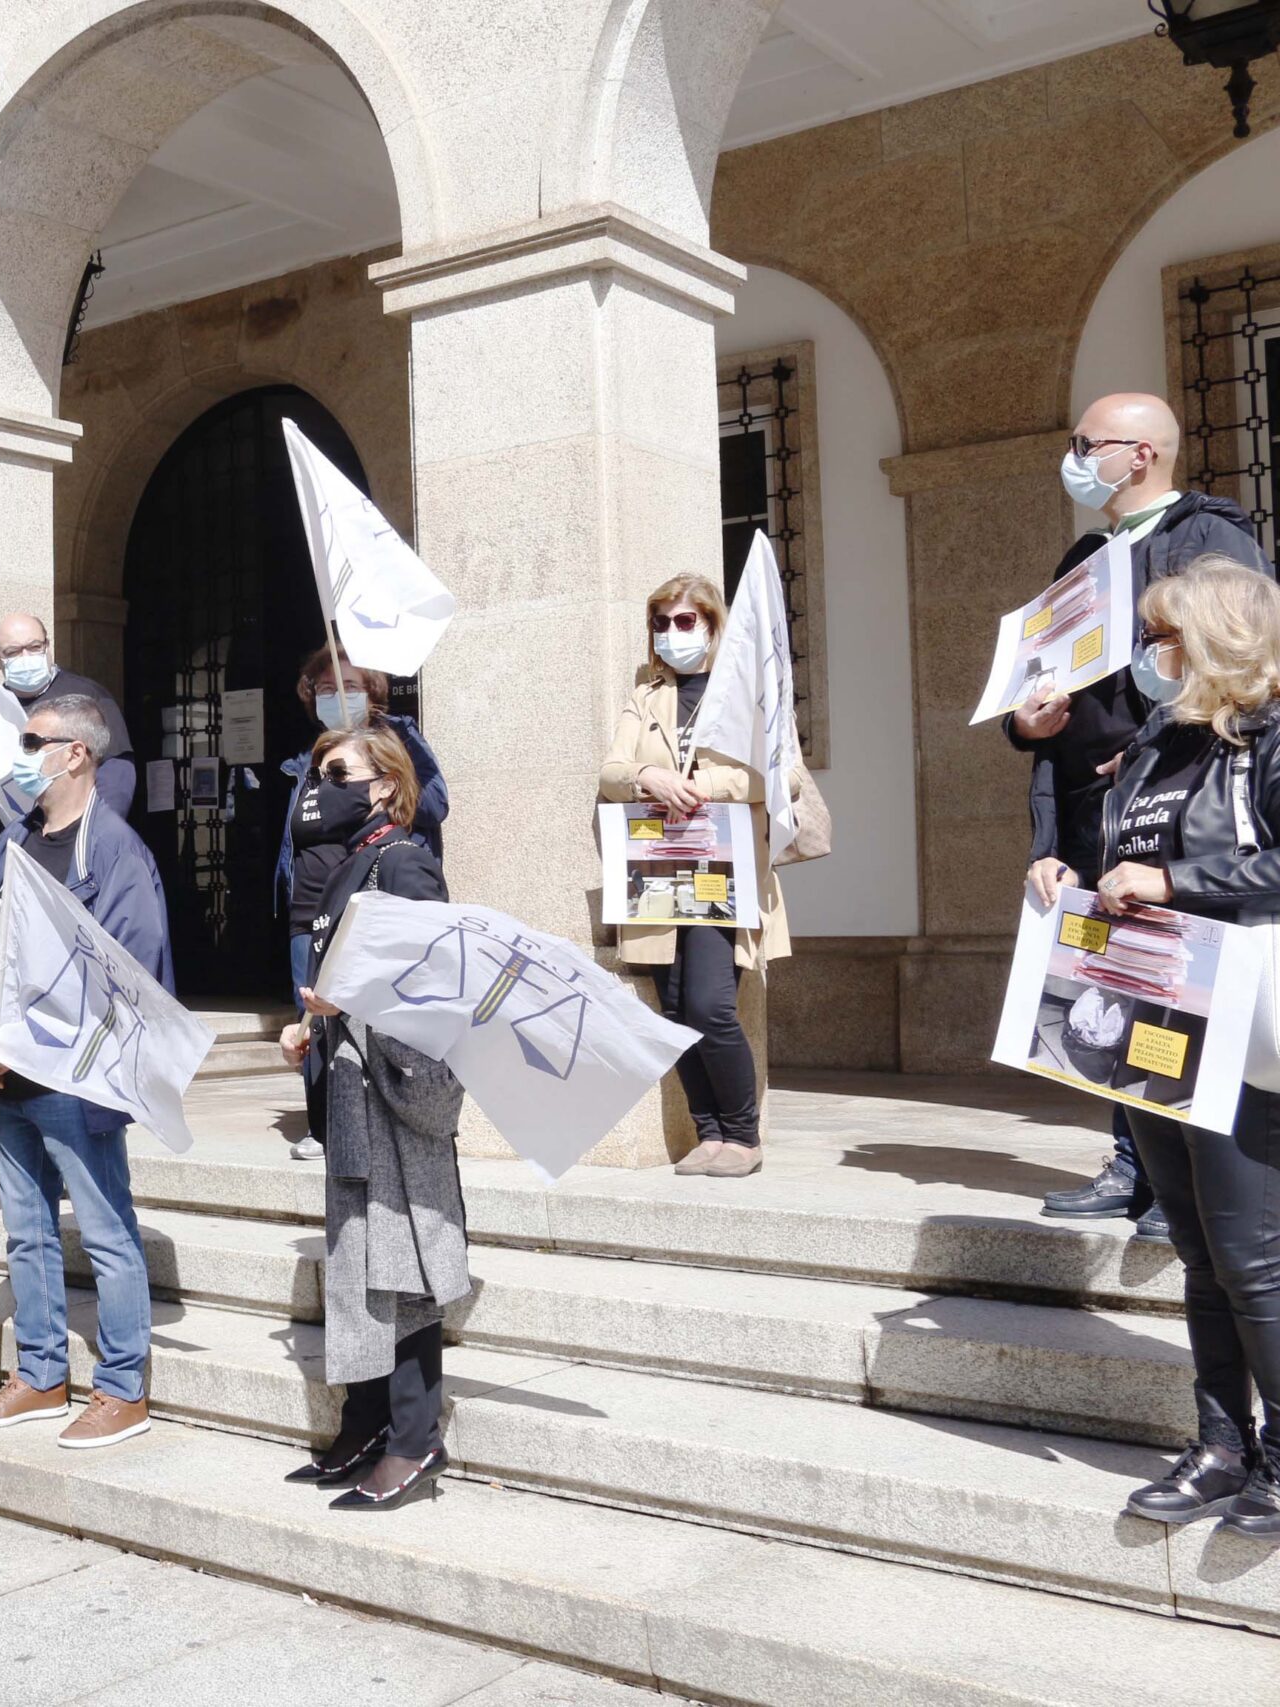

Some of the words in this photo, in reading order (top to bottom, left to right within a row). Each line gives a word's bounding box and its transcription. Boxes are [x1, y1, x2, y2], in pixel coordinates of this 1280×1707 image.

[1146, 789, 1189, 810] para
[1135, 807, 1171, 828] nela
[458, 916, 588, 996] S.F.J.
